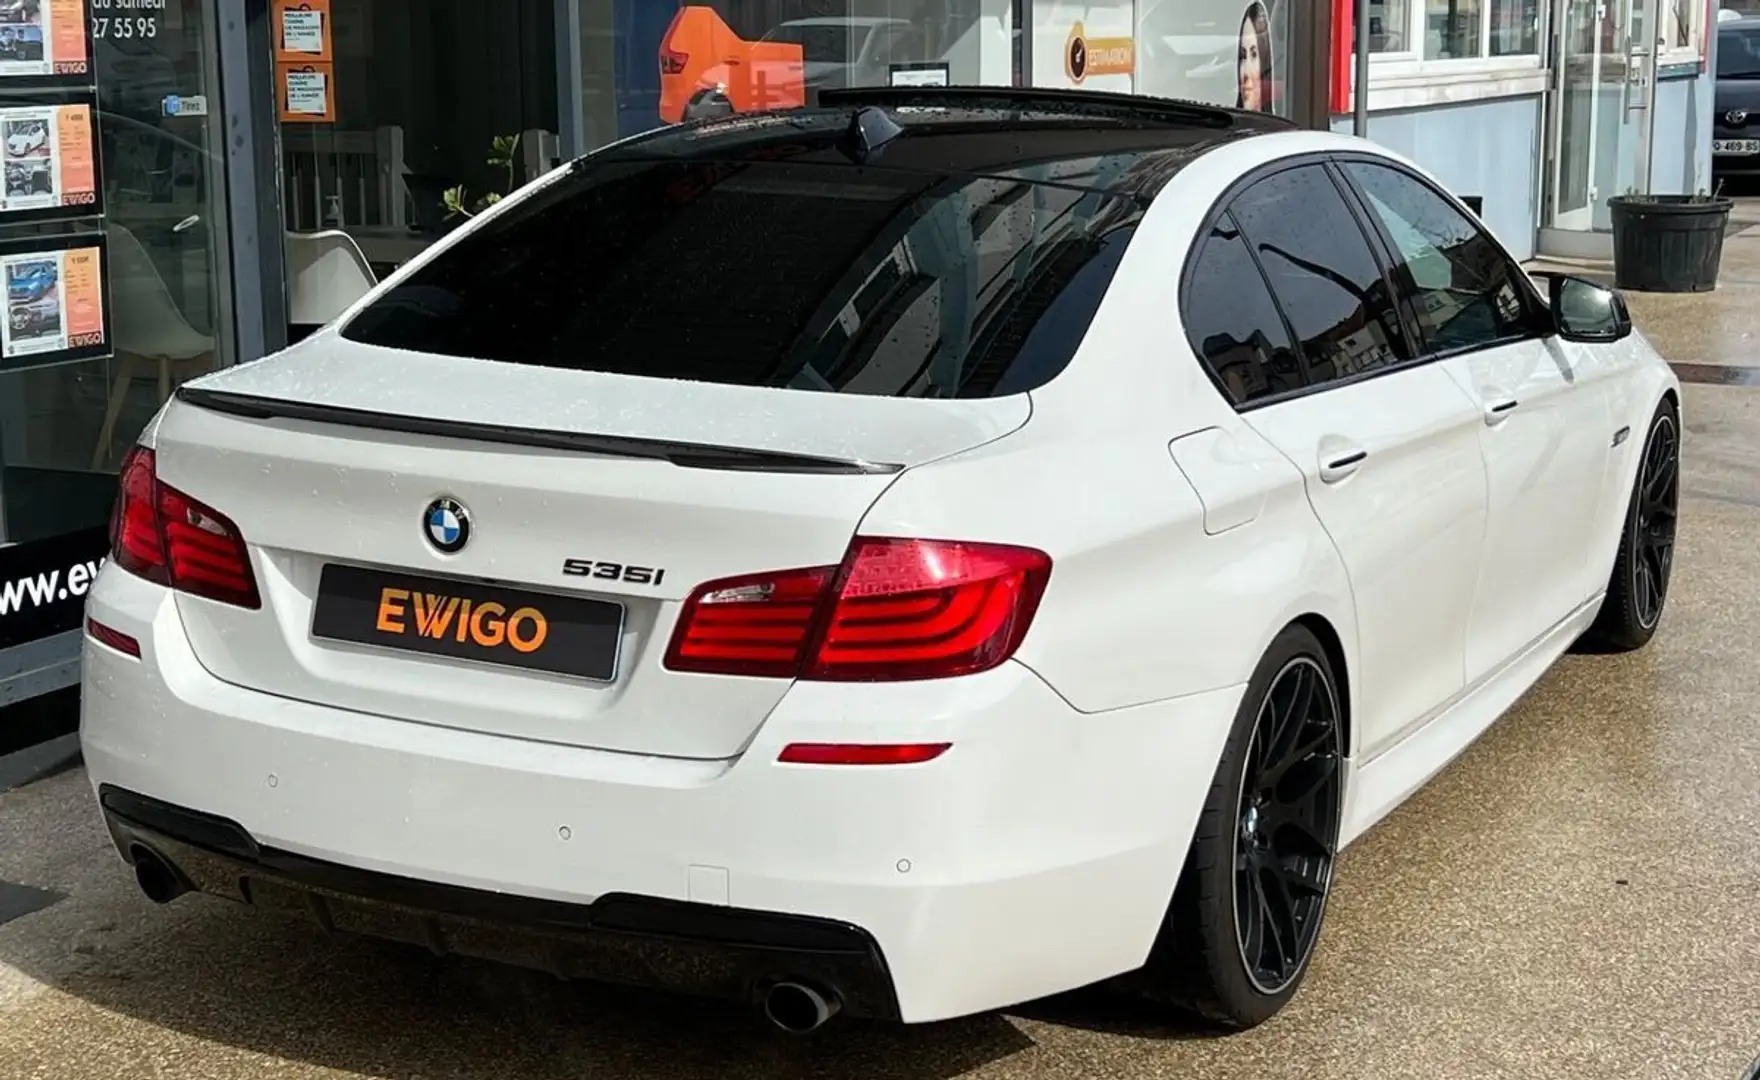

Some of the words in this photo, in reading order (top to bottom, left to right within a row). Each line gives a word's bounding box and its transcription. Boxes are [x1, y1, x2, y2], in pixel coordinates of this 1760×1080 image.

[114, 18, 133, 38] 55
[136, 17, 156, 38] 95
[54, 62, 87, 74] EWIGO
[62, 192, 95, 206] EWIGO
[69, 332, 101, 348] EWIGO
[376, 587, 548, 653] EWIGO
